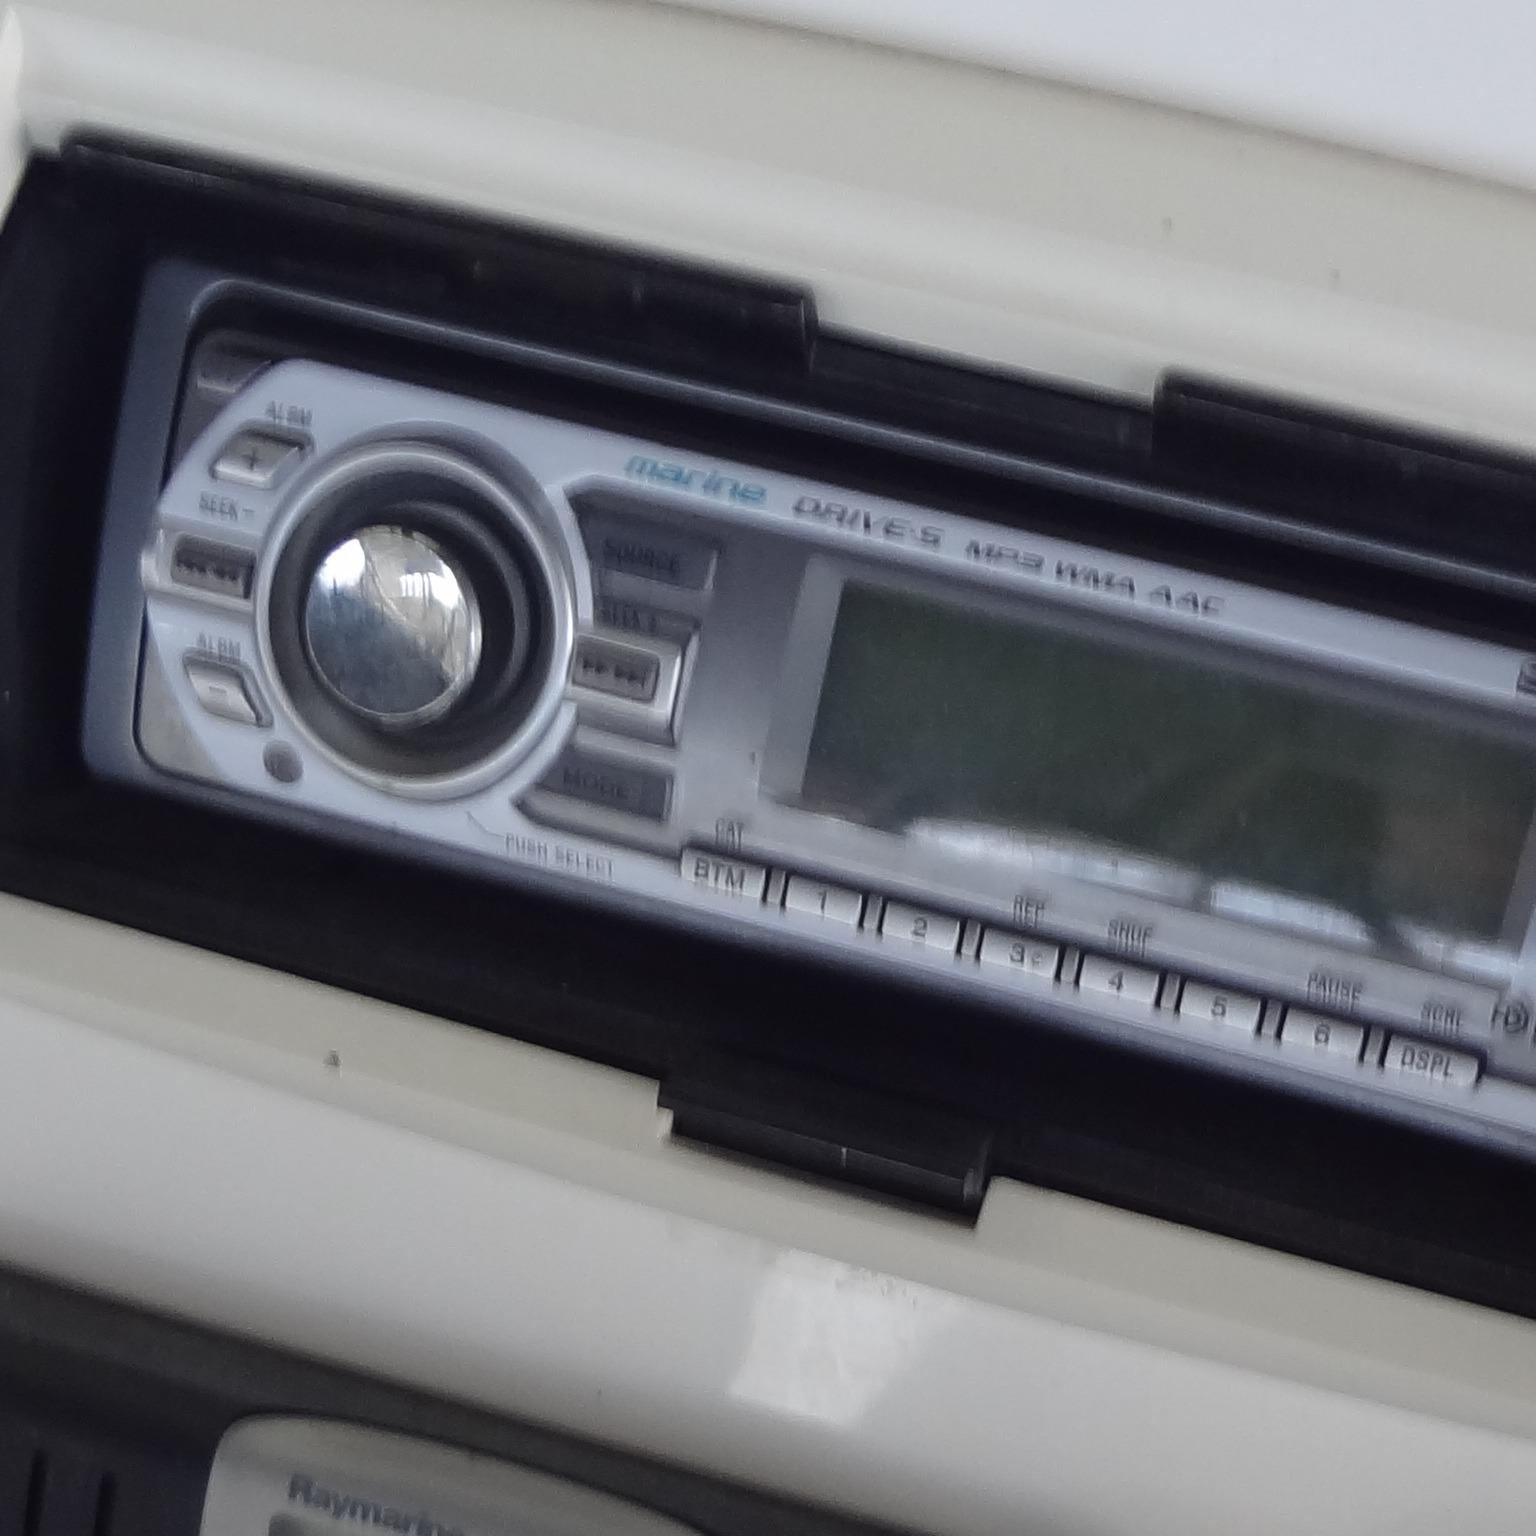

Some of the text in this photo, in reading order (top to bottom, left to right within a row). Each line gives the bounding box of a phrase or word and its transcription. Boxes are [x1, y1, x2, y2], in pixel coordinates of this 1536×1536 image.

[624, 454, 767, 504] marine
[964, 538, 1046, 574] MP3
[694, 857, 746, 892] BTM
[911, 916, 928, 938] 2
[1009, 942, 1026, 965] 3
[1106, 968, 1125, 992] 4
[1210, 994, 1228, 1019] 5
[1314, 1021, 1331, 1047] 6
[1400, 1044, 1454, 1079] DSPL
